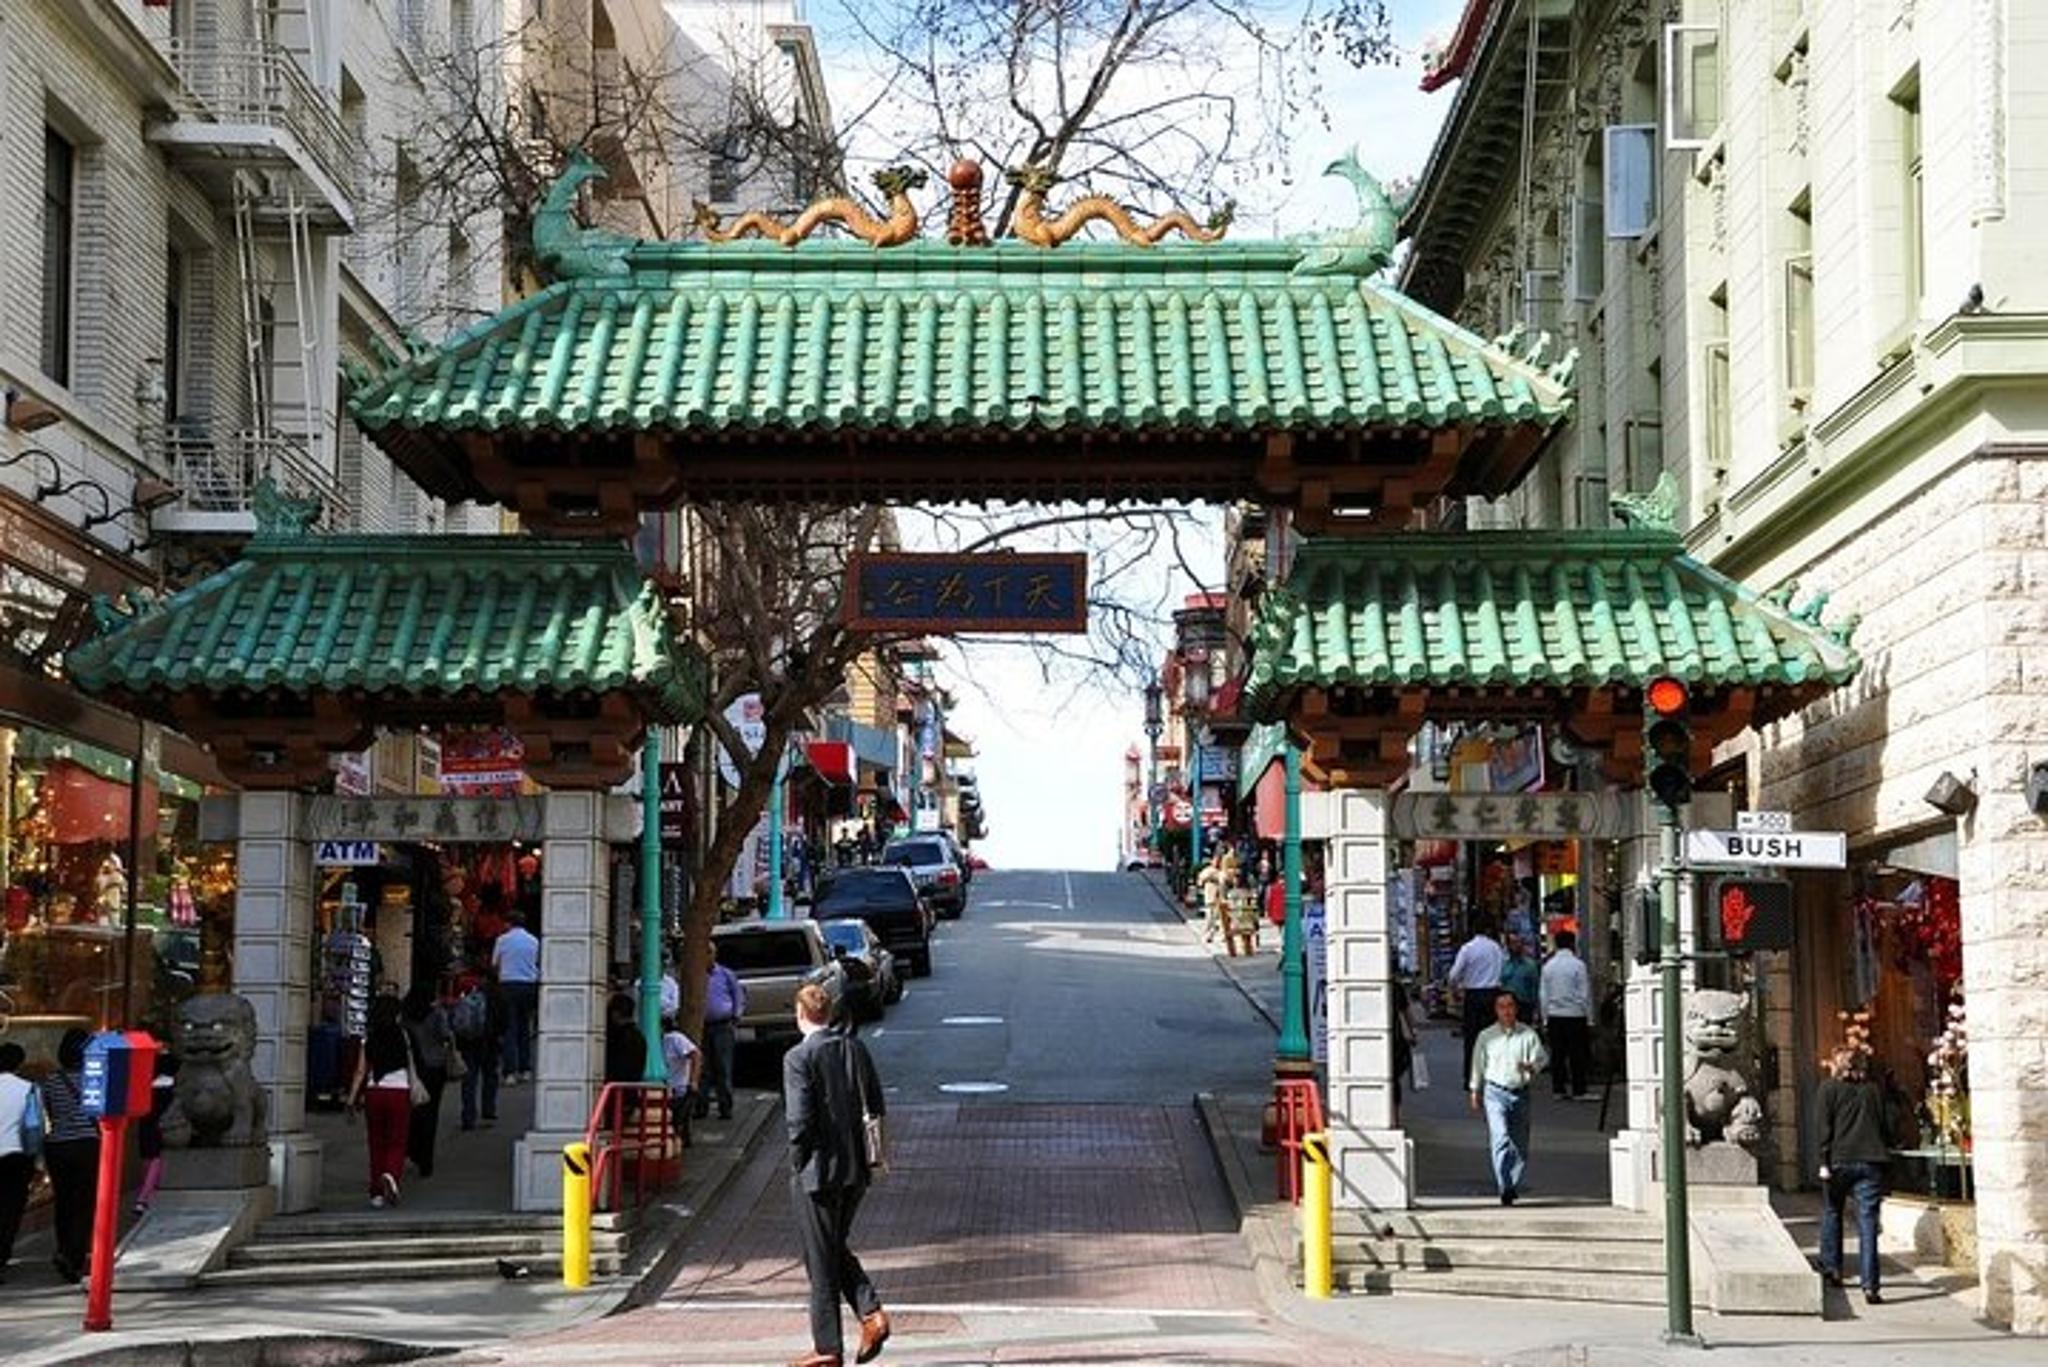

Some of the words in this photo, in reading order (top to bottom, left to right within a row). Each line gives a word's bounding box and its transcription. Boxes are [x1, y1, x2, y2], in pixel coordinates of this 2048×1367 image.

[1758, 813, 1787, 829] 500
[320, 841, 374, 860] ATM
[1727, 836, 1802, 858] BUSH
